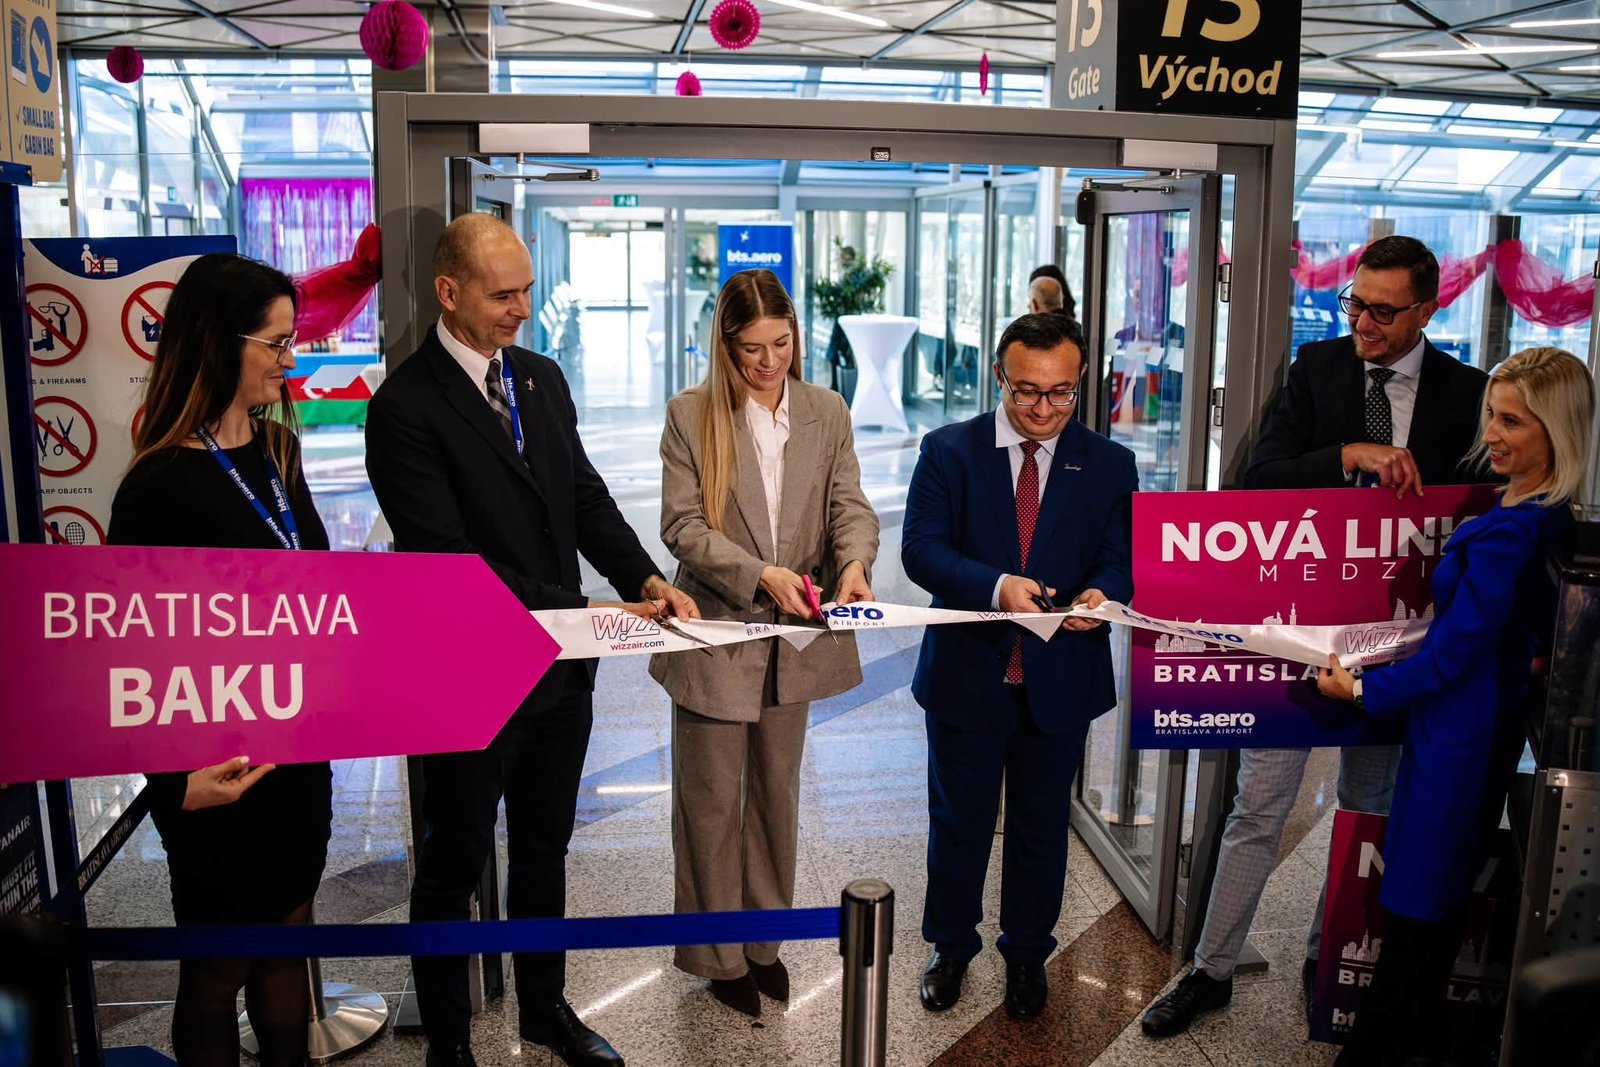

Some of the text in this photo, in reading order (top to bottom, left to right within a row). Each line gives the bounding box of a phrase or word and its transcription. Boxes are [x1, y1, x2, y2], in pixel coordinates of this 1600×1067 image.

[1068, 65, 1101, 100] Gate
[1138, 54, 1283, 100] Východ
[727, 250, 782, 263] bts.aero
[57, 487, 93, 495] OBJECTS
[1161, 508, 1327, 562] NOVÁ
[44, 592, 359, 638] BRATISLAVA
[610, 640, 665, 651] wizzair.com
[109, 663, 304, 728] BAKU
[1154, 709, 1256, 728] bts.aero
[1216, 727, 1253, 735] AIRPORT
[0, 815, 31, 850] ANAIR
